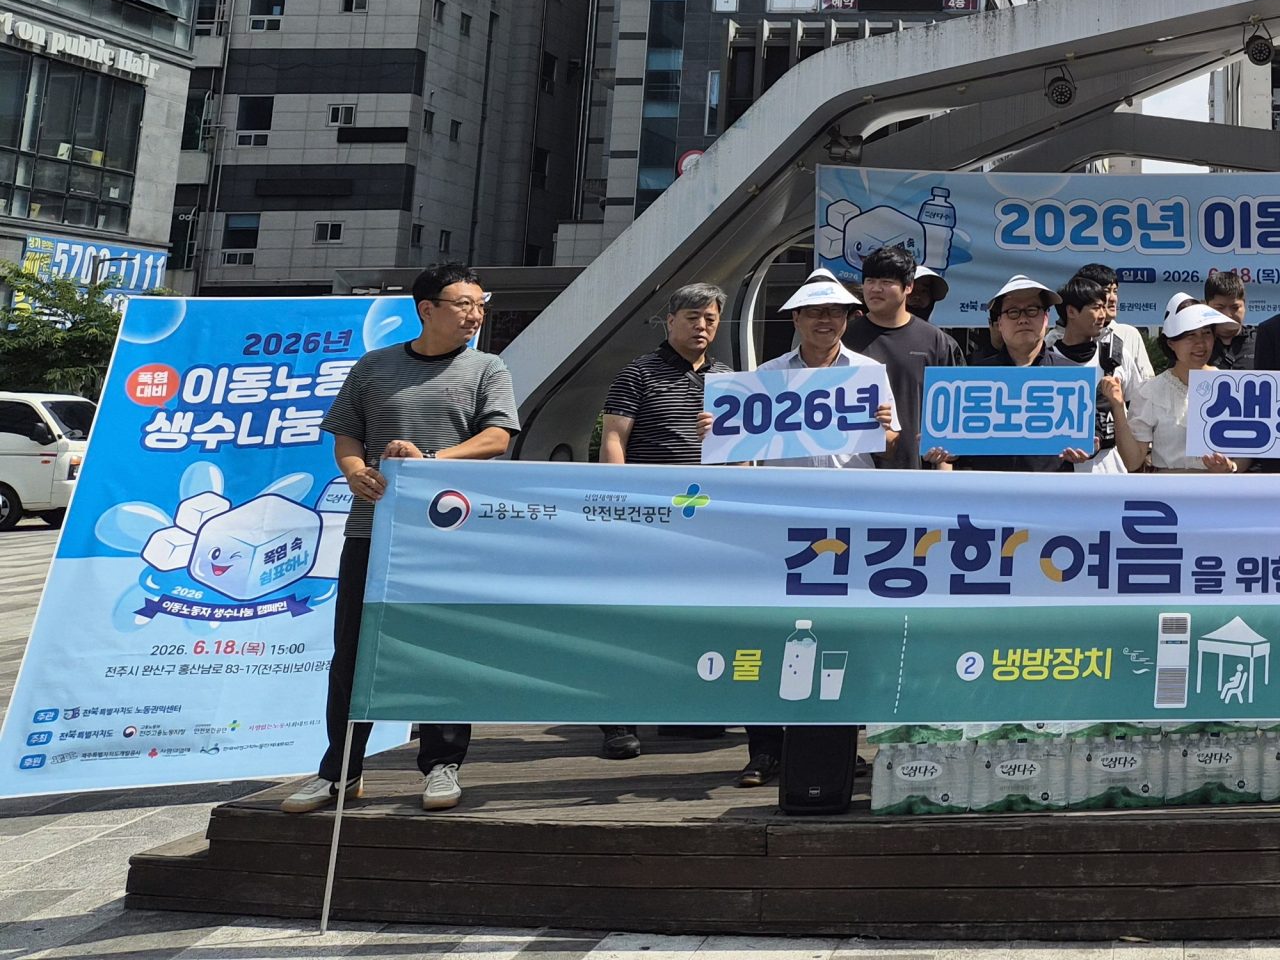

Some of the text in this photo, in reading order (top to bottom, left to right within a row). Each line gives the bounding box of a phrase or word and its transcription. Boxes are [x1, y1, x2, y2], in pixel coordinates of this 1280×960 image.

[16, 21, 161, 80] on public Hair
[1000, 199, 1187, 250] 2026년
[1121, 270, 1148, 282] 일시
[1163, 270, 1204, 284] 2026.
[1116, 302, 1157, 312] 동권익센터
[243, 328, 353, 356] 2026년
[137, 370, 169, 385] 폭염
[135, 384, 168, 398] 대비
[712, 382, 880, 436] 2026년
[931, 383, 1090, 435] 이동노동자
[144, 406, 325, 450] 생수나눔
[477, 502, 672, 524] 고용노동부 안전보건공단
[262, 536, 304, 566] 폭염 속
[783, 513, 1030, 600] 건강한
[258, 551, 311, 586] 쉼표하나
[171, 585, 204, 600] 2026
[161, 600, 289, 619] 이동노동자 생수나눔 캠페인
[149, 639, 306, 657] 2026. 6.18.(목) 15:00
[104, 665, 139, 679] 전주시
[141, 663, 176, 677] 완산구
[177, 662, 224, 676] 홍산남로
[730, 648, 763, 682] 물
[990, 647, 1114, 683] 냉방장치
[1107, 756, 1138, 770] 삼다수
[1202, 752, 1233, 766] 삼다수
[908, 763, 938, 778] 삼다수
[1006, 763, 1037, 777] 삼다수
